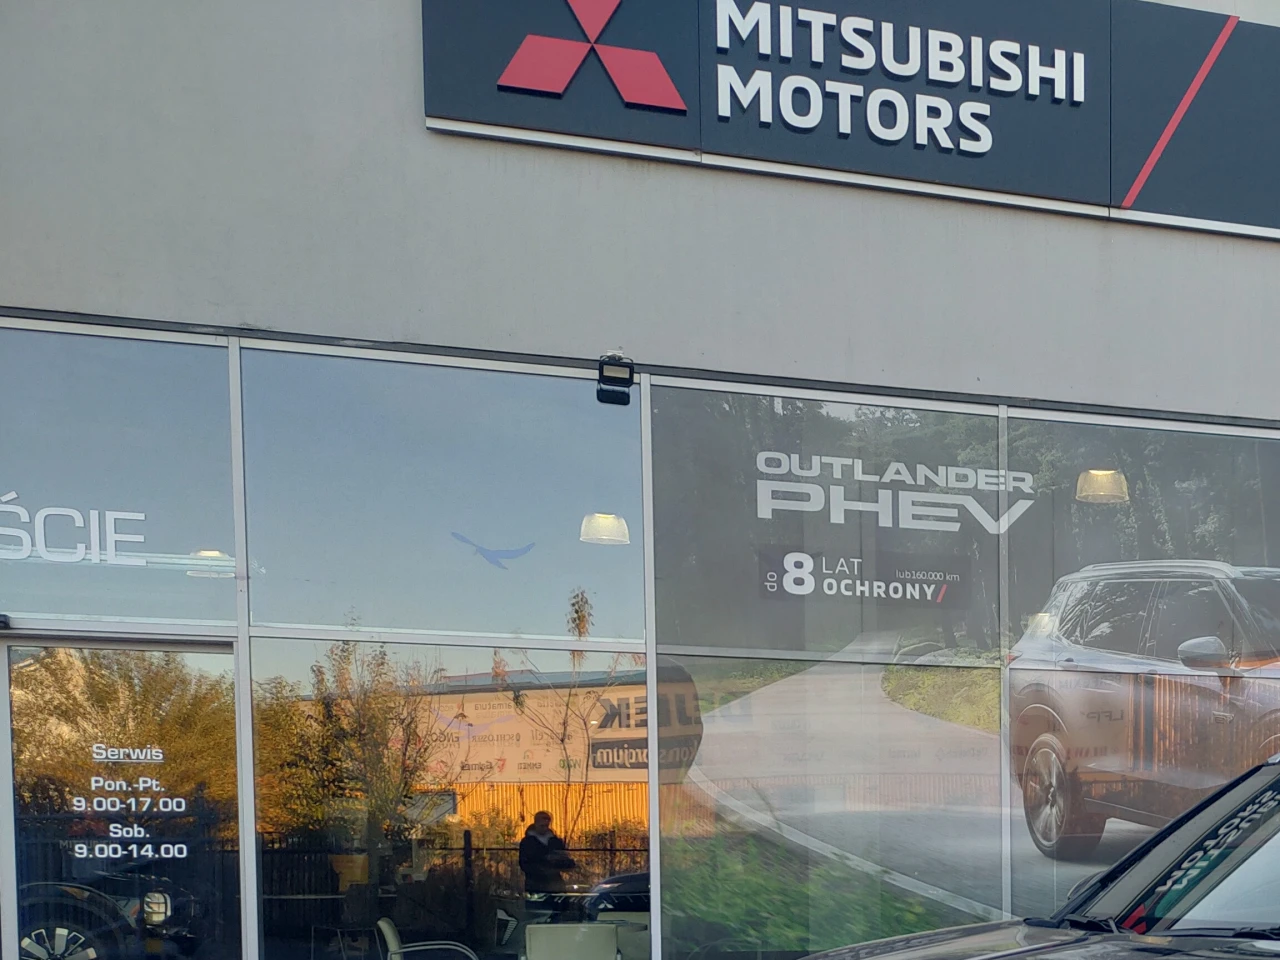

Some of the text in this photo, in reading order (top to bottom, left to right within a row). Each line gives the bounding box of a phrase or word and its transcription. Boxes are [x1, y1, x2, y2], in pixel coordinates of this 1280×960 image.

[716, 0, 1086, 103] MITSUBISHI
[716, 63, 994, 154] MOTORS
[756, 451, 1036, 494] OUTLANDER
[756, 479, 1036, 535] PHEV
[782, 552, 816, 596] 8
[822, 557, 863, 576] LAT
[92, 744, 165, 761] Serwis
[90, 776, 166, 792] Pon.-Pt.
[72, 797, 187, 813] 9.00-17.00
[108, 823, 151, 839] Sob.
[74, 843, 188, 859] 9.00-14.00
